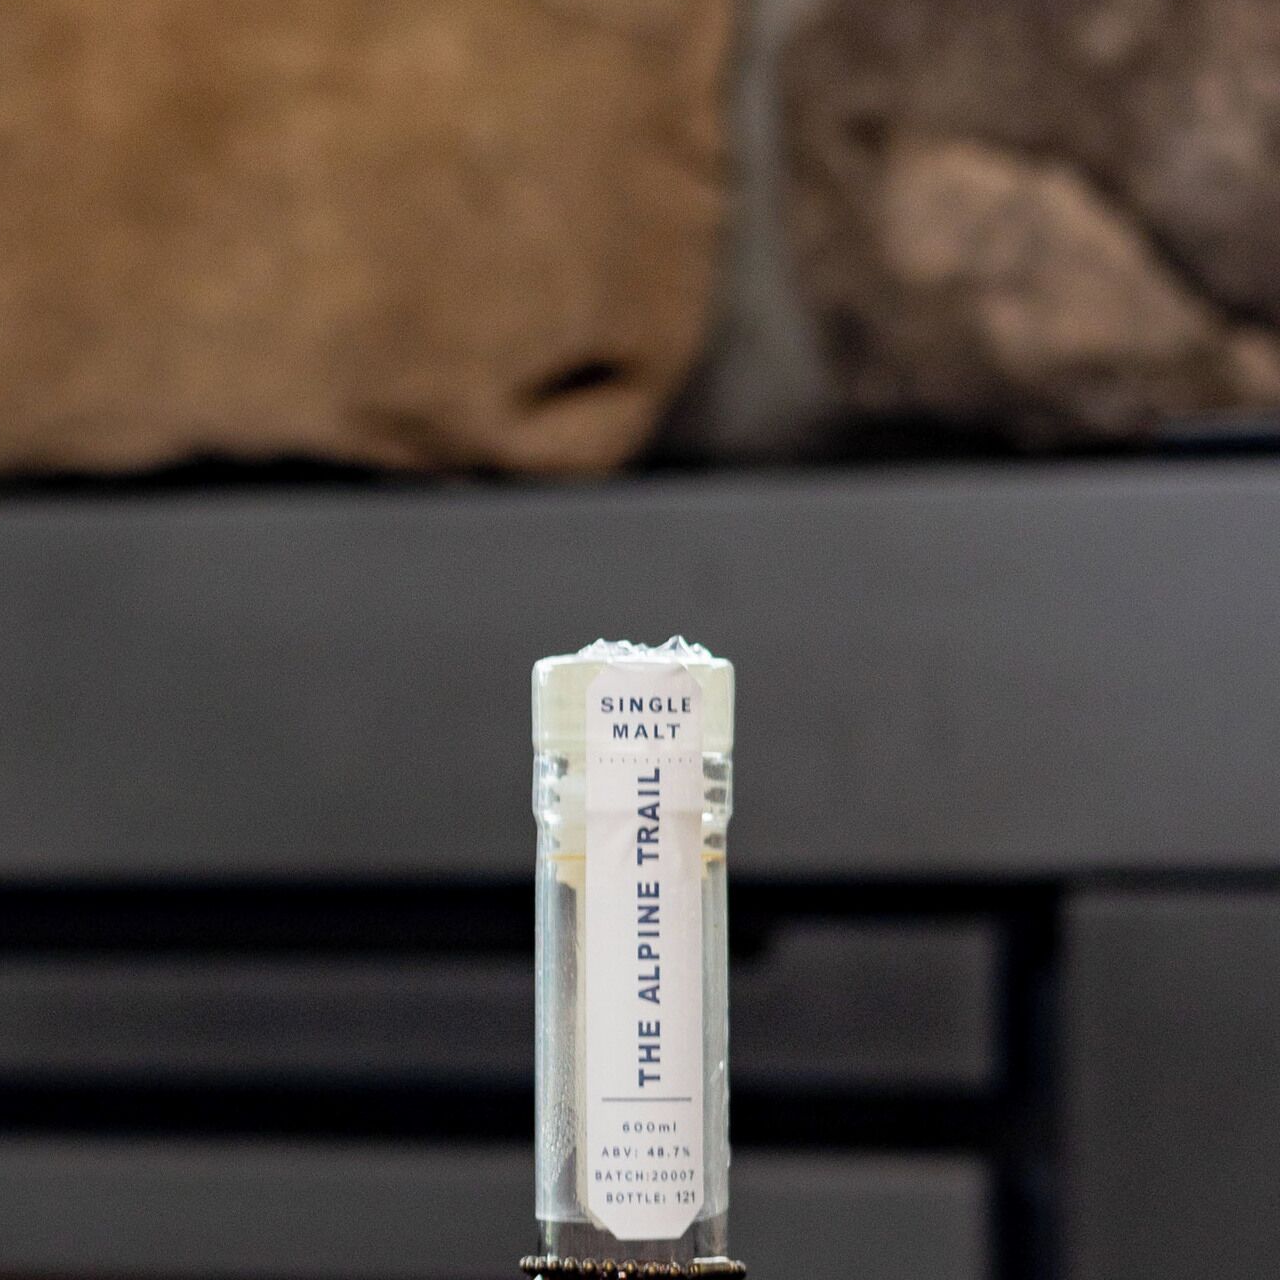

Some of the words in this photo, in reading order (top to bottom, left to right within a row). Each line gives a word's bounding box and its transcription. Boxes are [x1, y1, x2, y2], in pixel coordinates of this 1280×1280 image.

[600, 697, 691, 713] SINGLE
[612, 723, 680, 739] MALT
[636, 768, 660, 866] TRAIL
[637, 882, 661, 1005] ALPINE
[637, 1021, 661, 1088] THE
